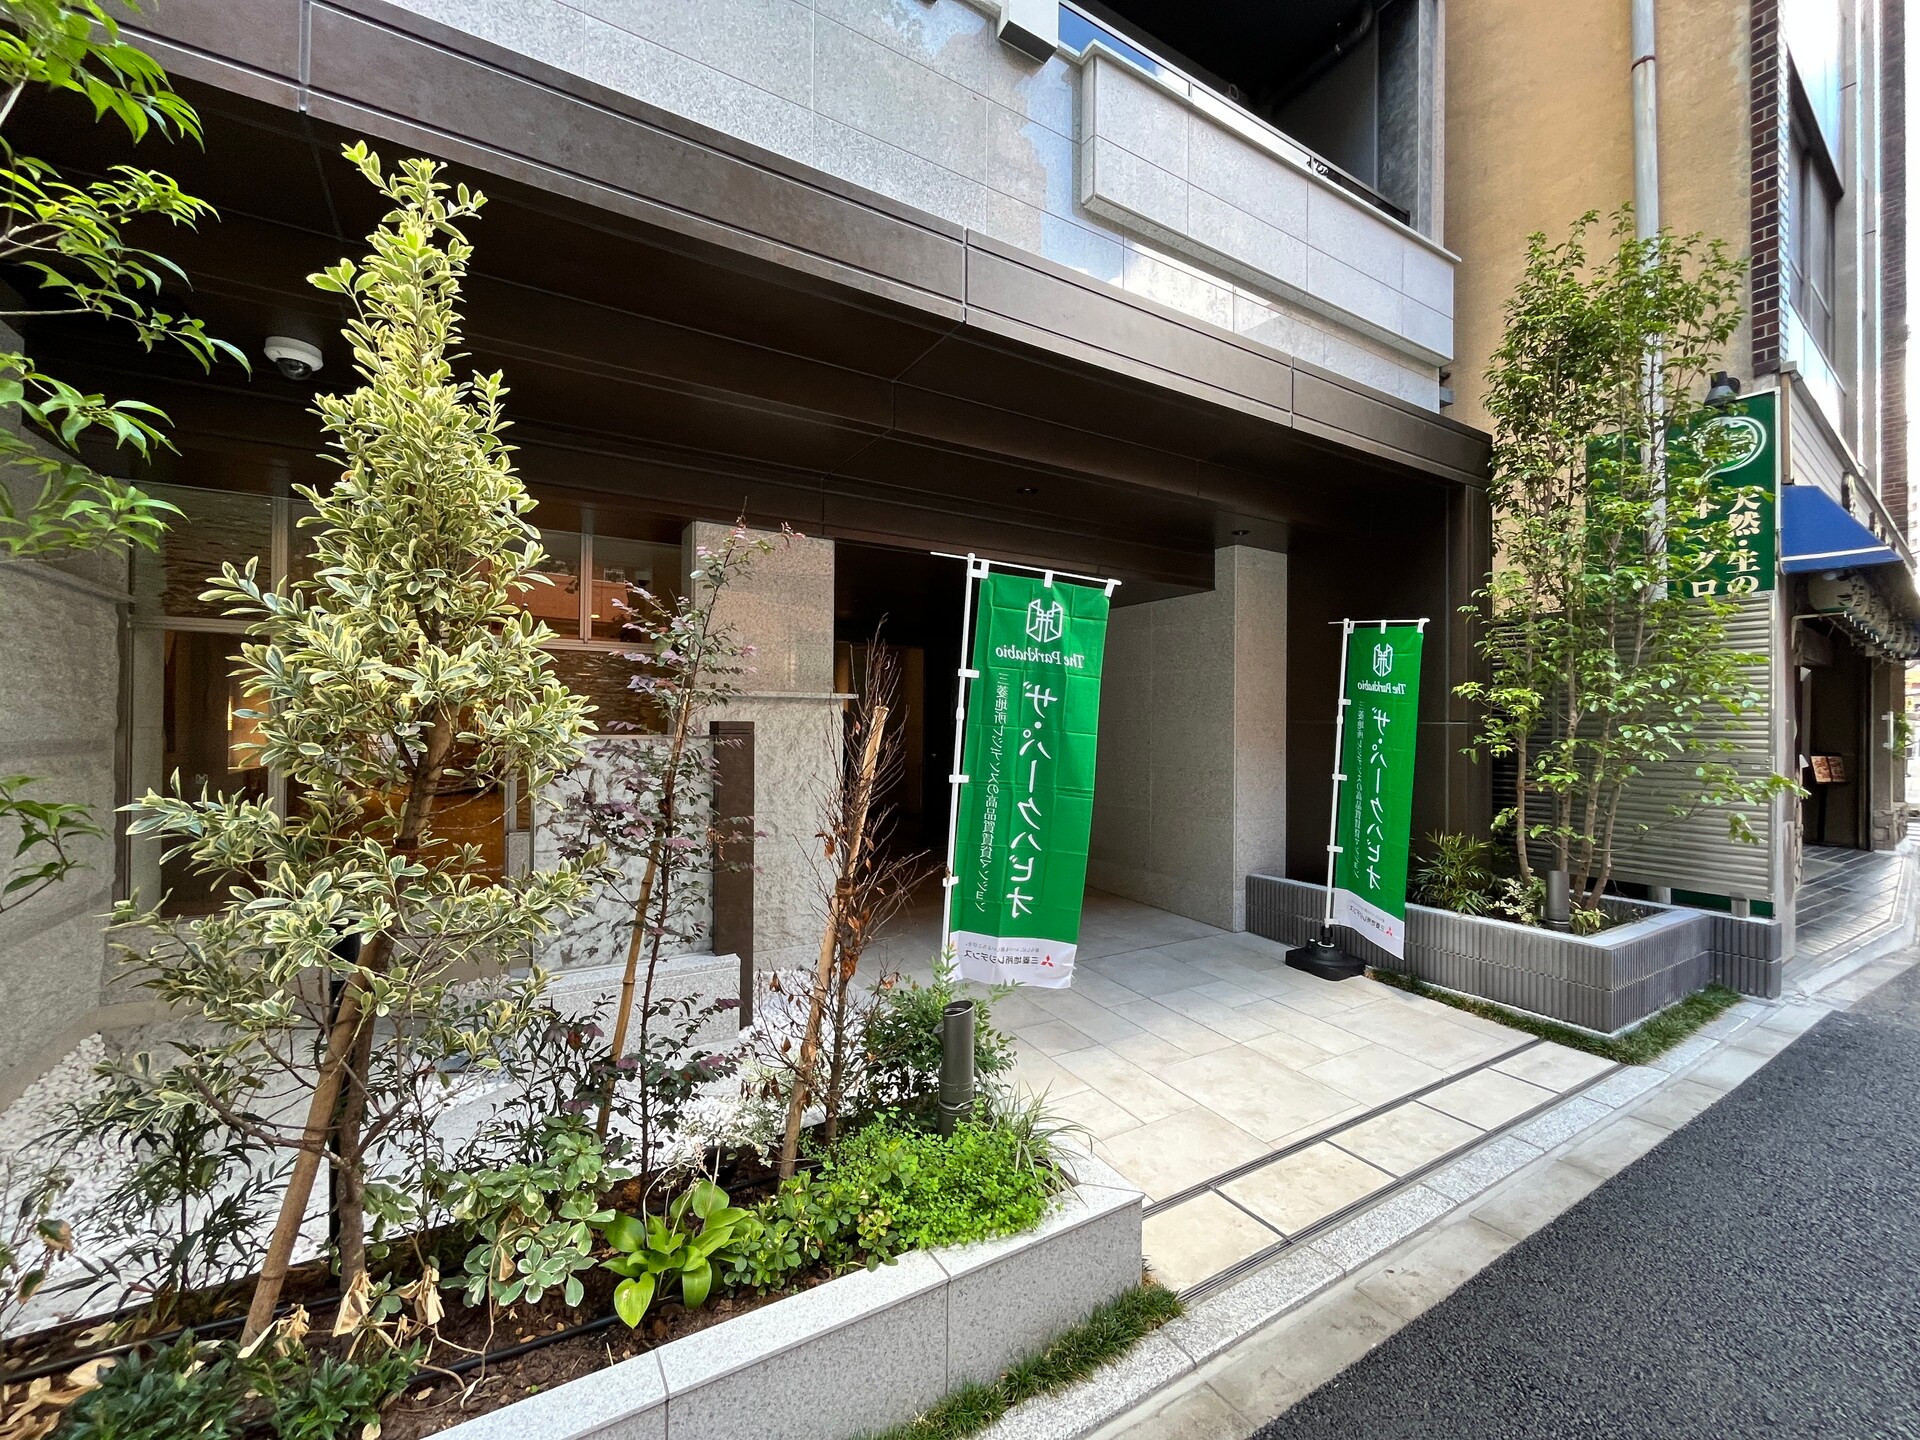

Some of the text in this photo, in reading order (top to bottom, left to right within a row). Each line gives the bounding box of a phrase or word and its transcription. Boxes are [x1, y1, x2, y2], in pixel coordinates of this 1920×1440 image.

[1726, 486, 1761, 594] 天然・生の
